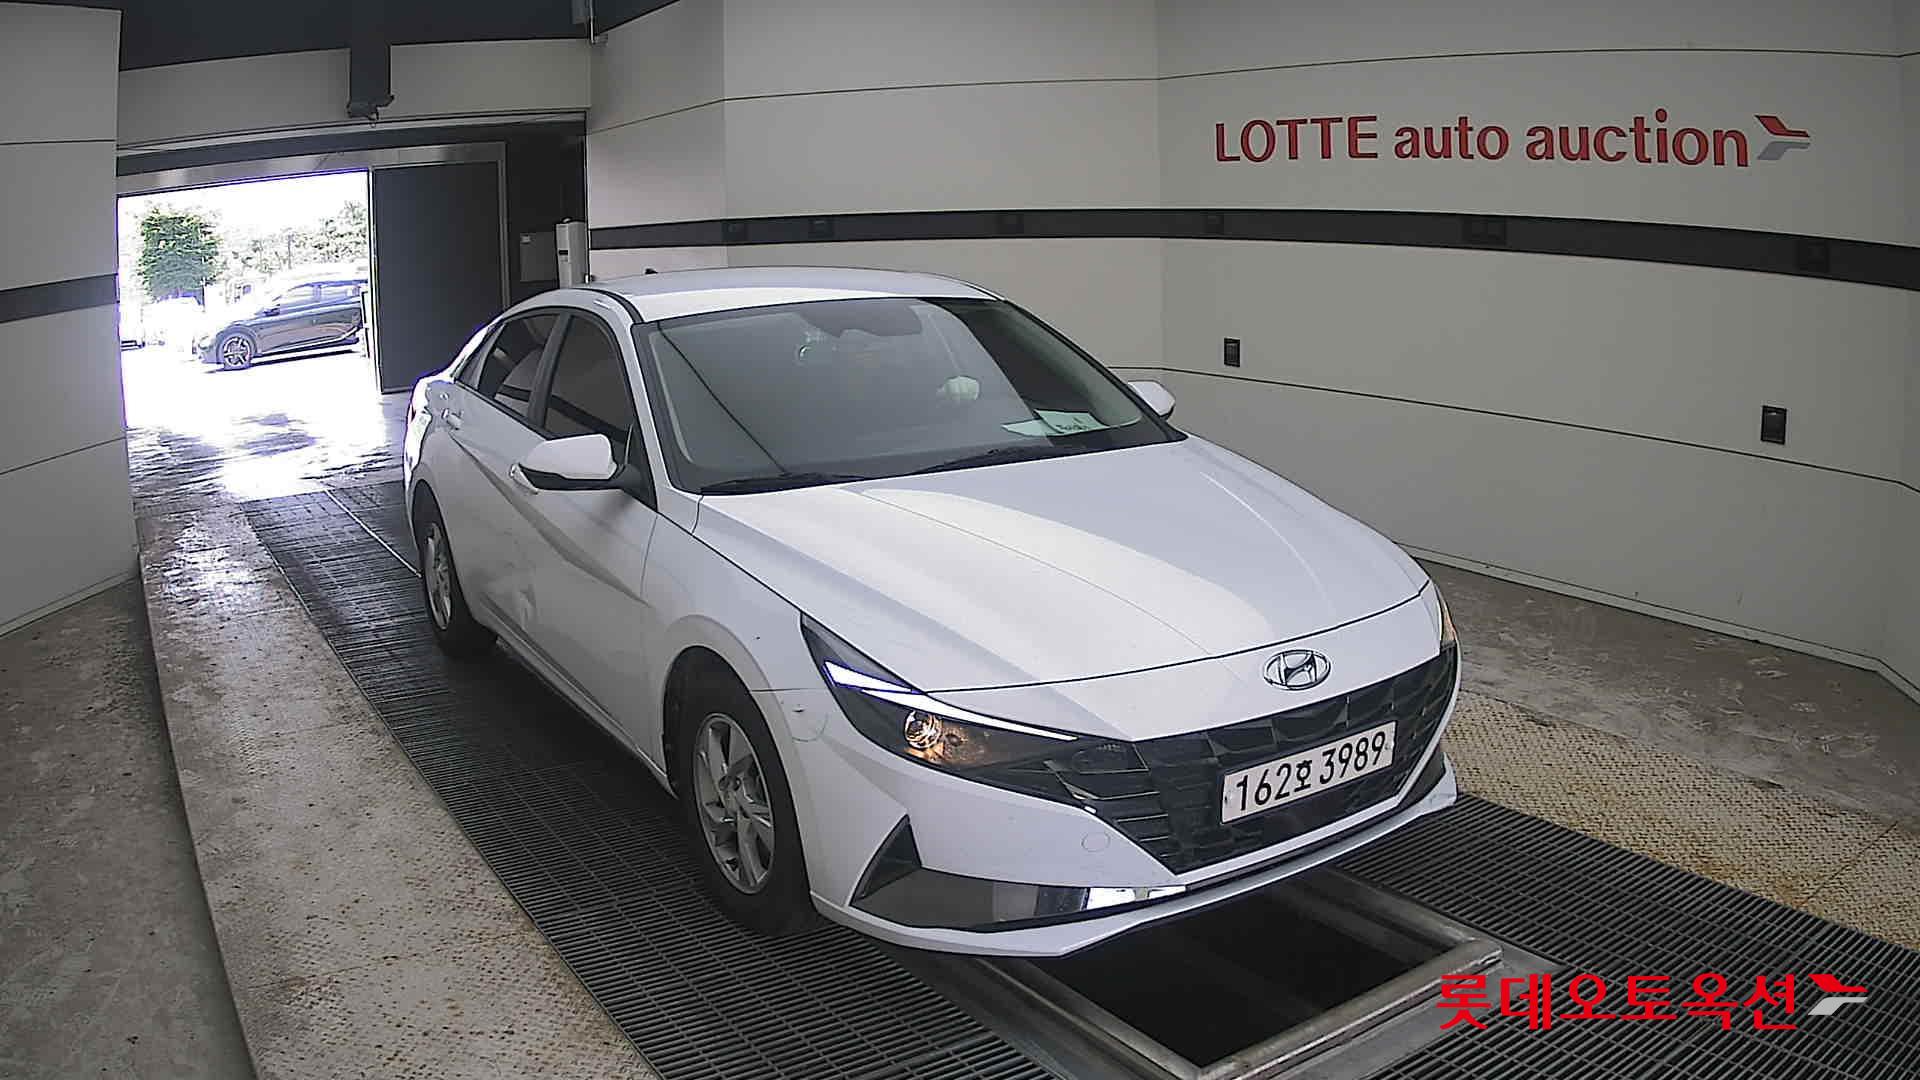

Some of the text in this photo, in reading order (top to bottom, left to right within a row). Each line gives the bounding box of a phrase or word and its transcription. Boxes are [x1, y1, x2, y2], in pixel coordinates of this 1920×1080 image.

[1215, 108, 1749, 168] LOTTE auto auction
[1236, 731, 1386, 811] 162호 3989
